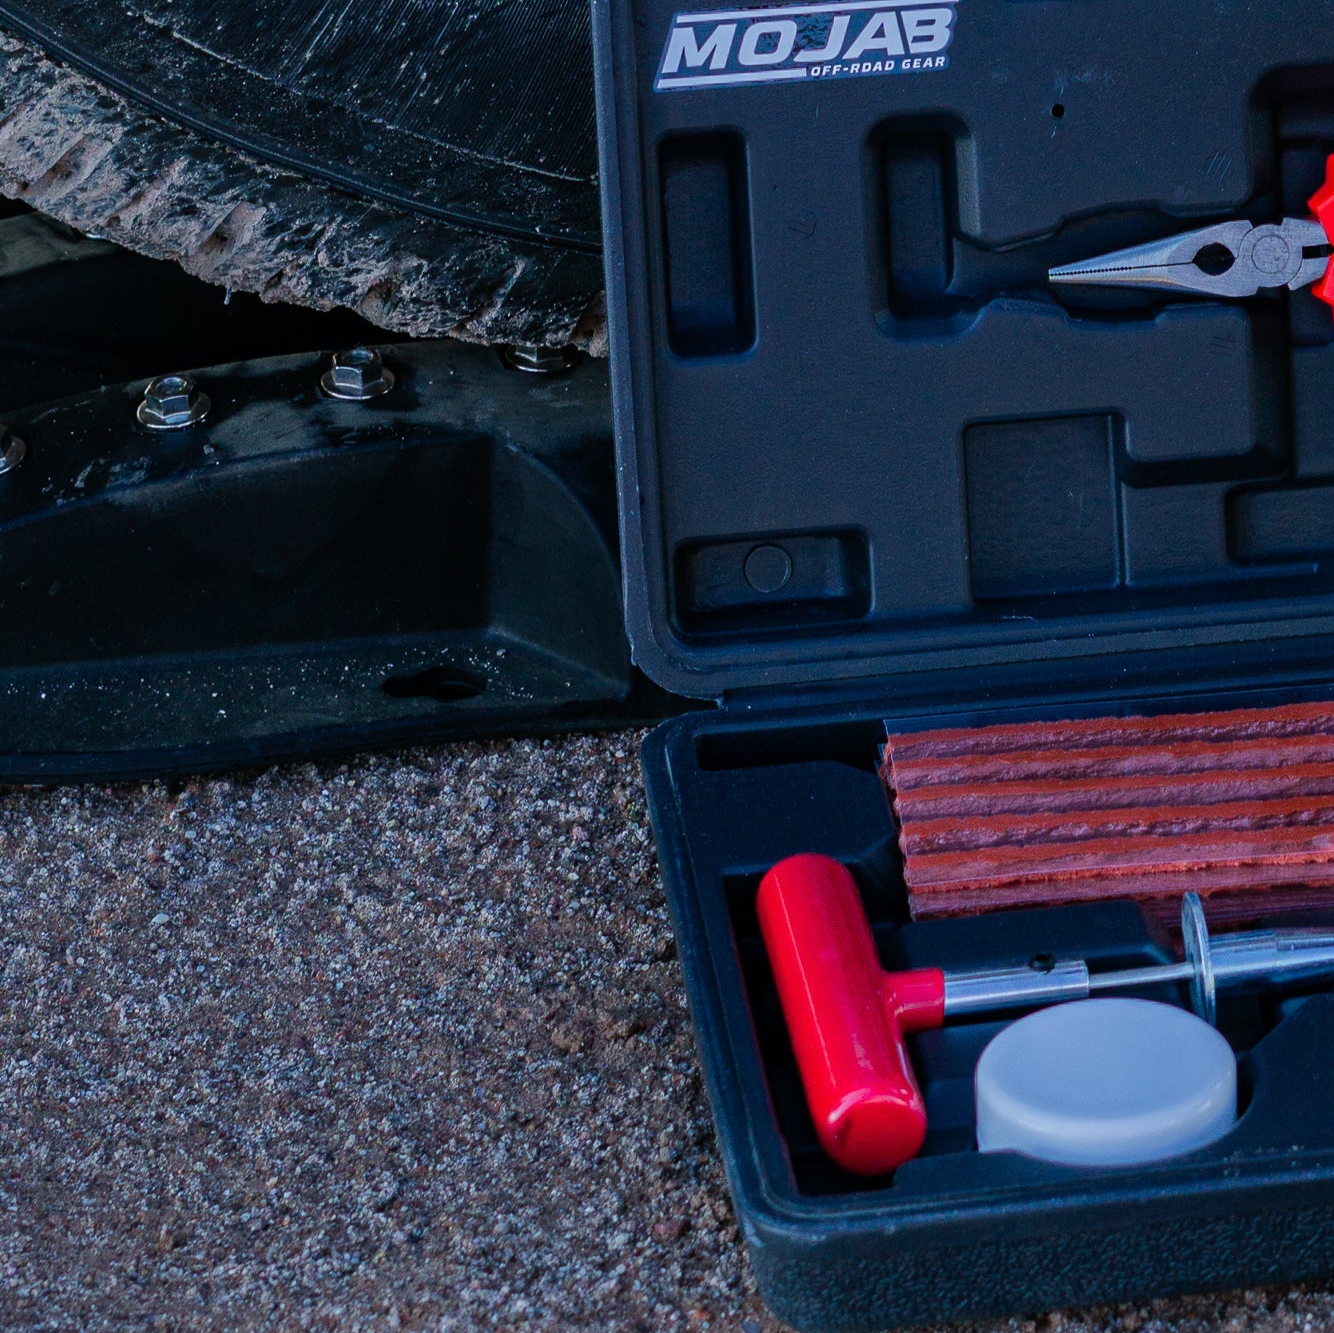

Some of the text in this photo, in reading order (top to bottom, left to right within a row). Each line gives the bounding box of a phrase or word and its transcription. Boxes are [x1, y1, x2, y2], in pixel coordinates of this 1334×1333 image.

[662, 7, 954, 74] MOJAB
[811, 55, 946, 77] OFF-ROAD GEAR
